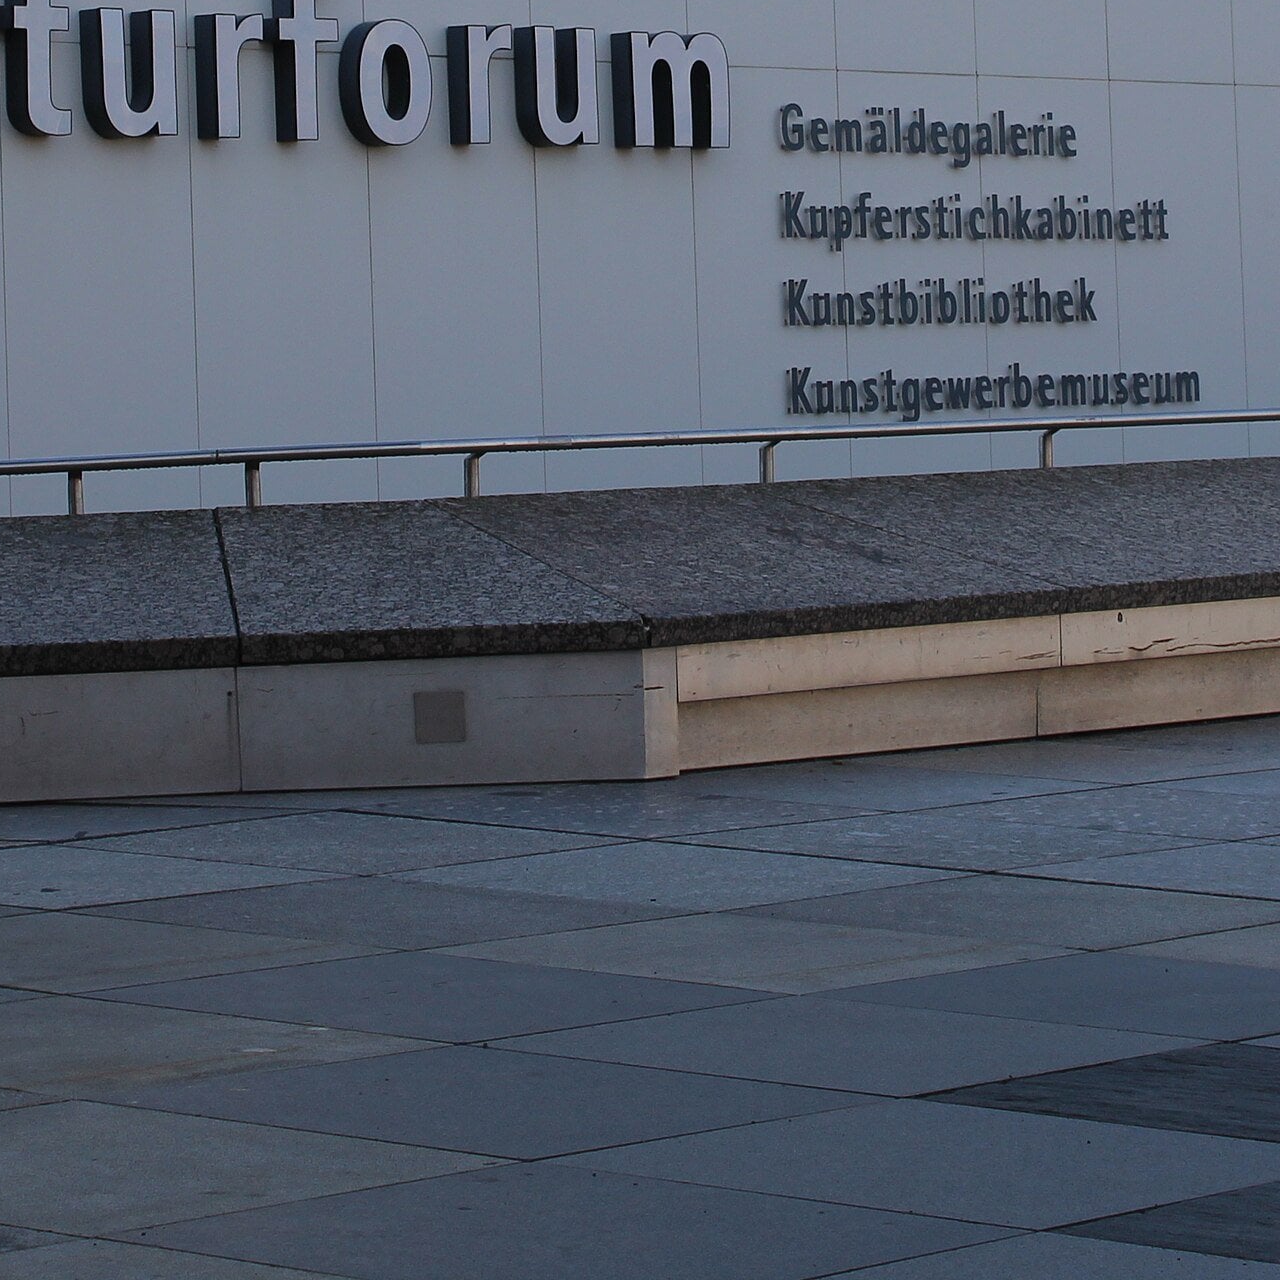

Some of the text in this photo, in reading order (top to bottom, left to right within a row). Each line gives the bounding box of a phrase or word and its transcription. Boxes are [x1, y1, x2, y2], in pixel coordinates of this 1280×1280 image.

[780, 103, 1077, 168] Gemäldegalerie
[780, 191, 1169, 252] Kupferstichkabinett
[783, 277, 1097, 326] Kunstbibliothek
[786, 362, 1200, 421] Kunstgewerbemuseum
